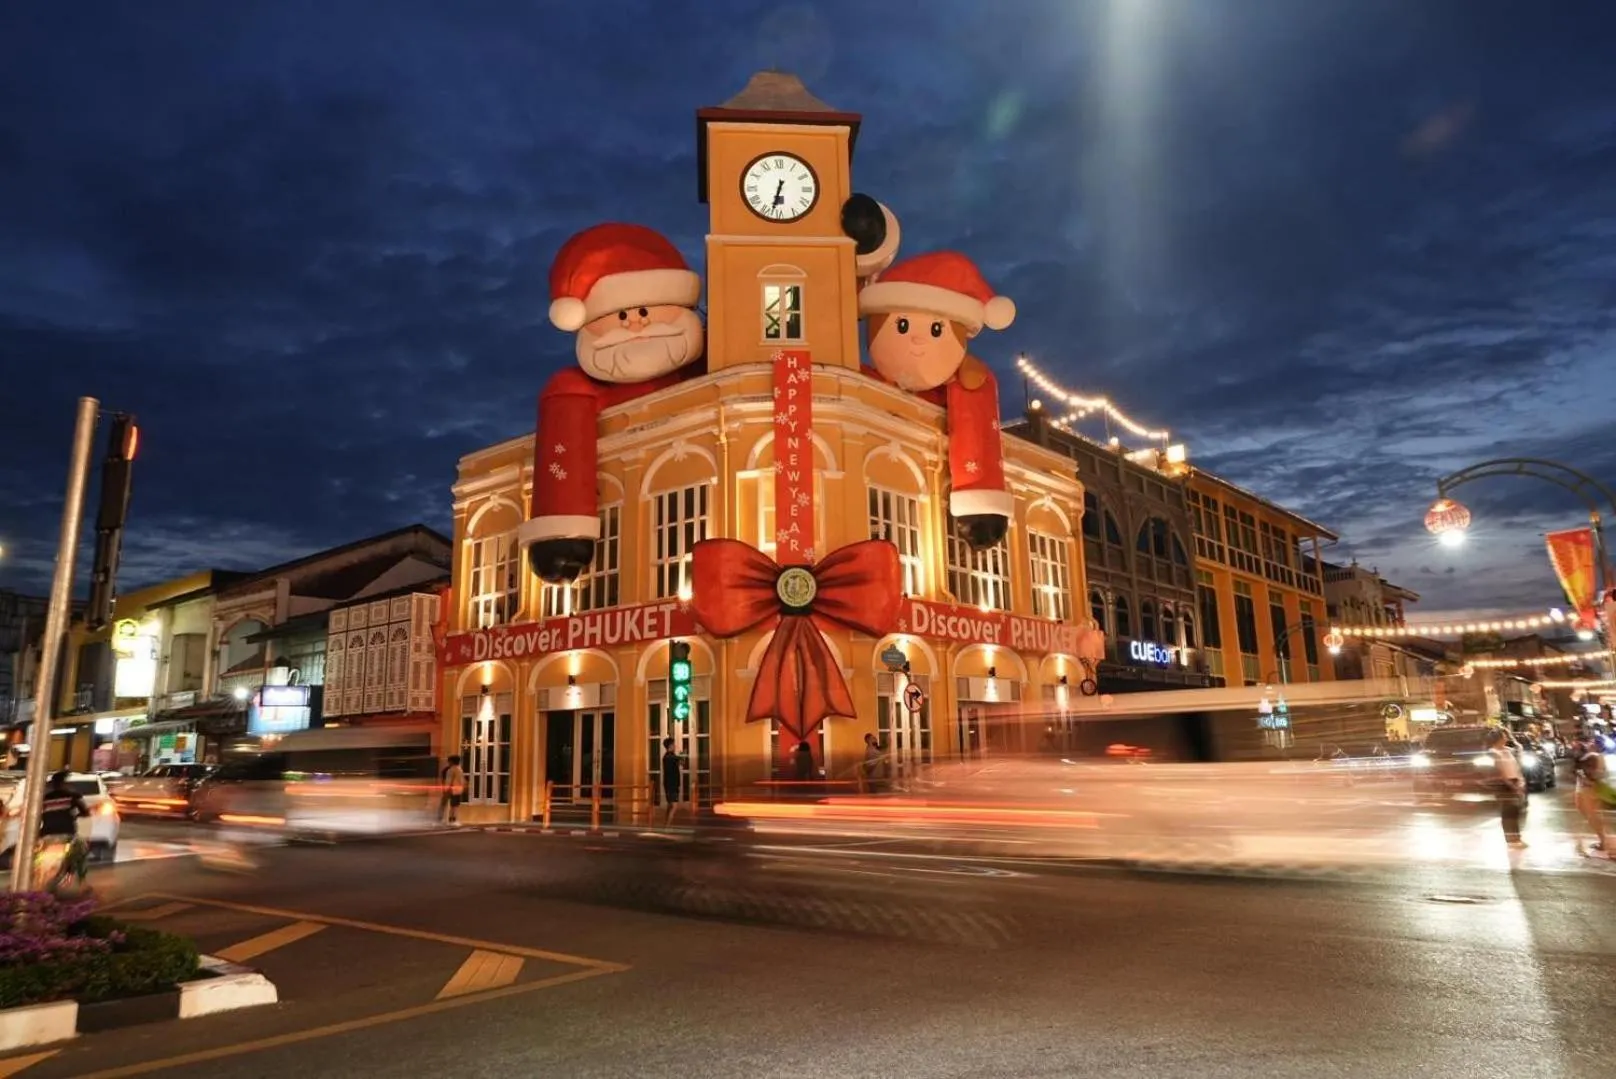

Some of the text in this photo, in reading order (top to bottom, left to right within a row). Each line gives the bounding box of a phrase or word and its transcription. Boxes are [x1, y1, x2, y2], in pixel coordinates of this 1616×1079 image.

[786, 357, 800, 552] HAPPY NEW YEAR
[473, 603, 677, 660] Discover PHUKET
[912, 602, 1077, 651] Discover PHUKE
